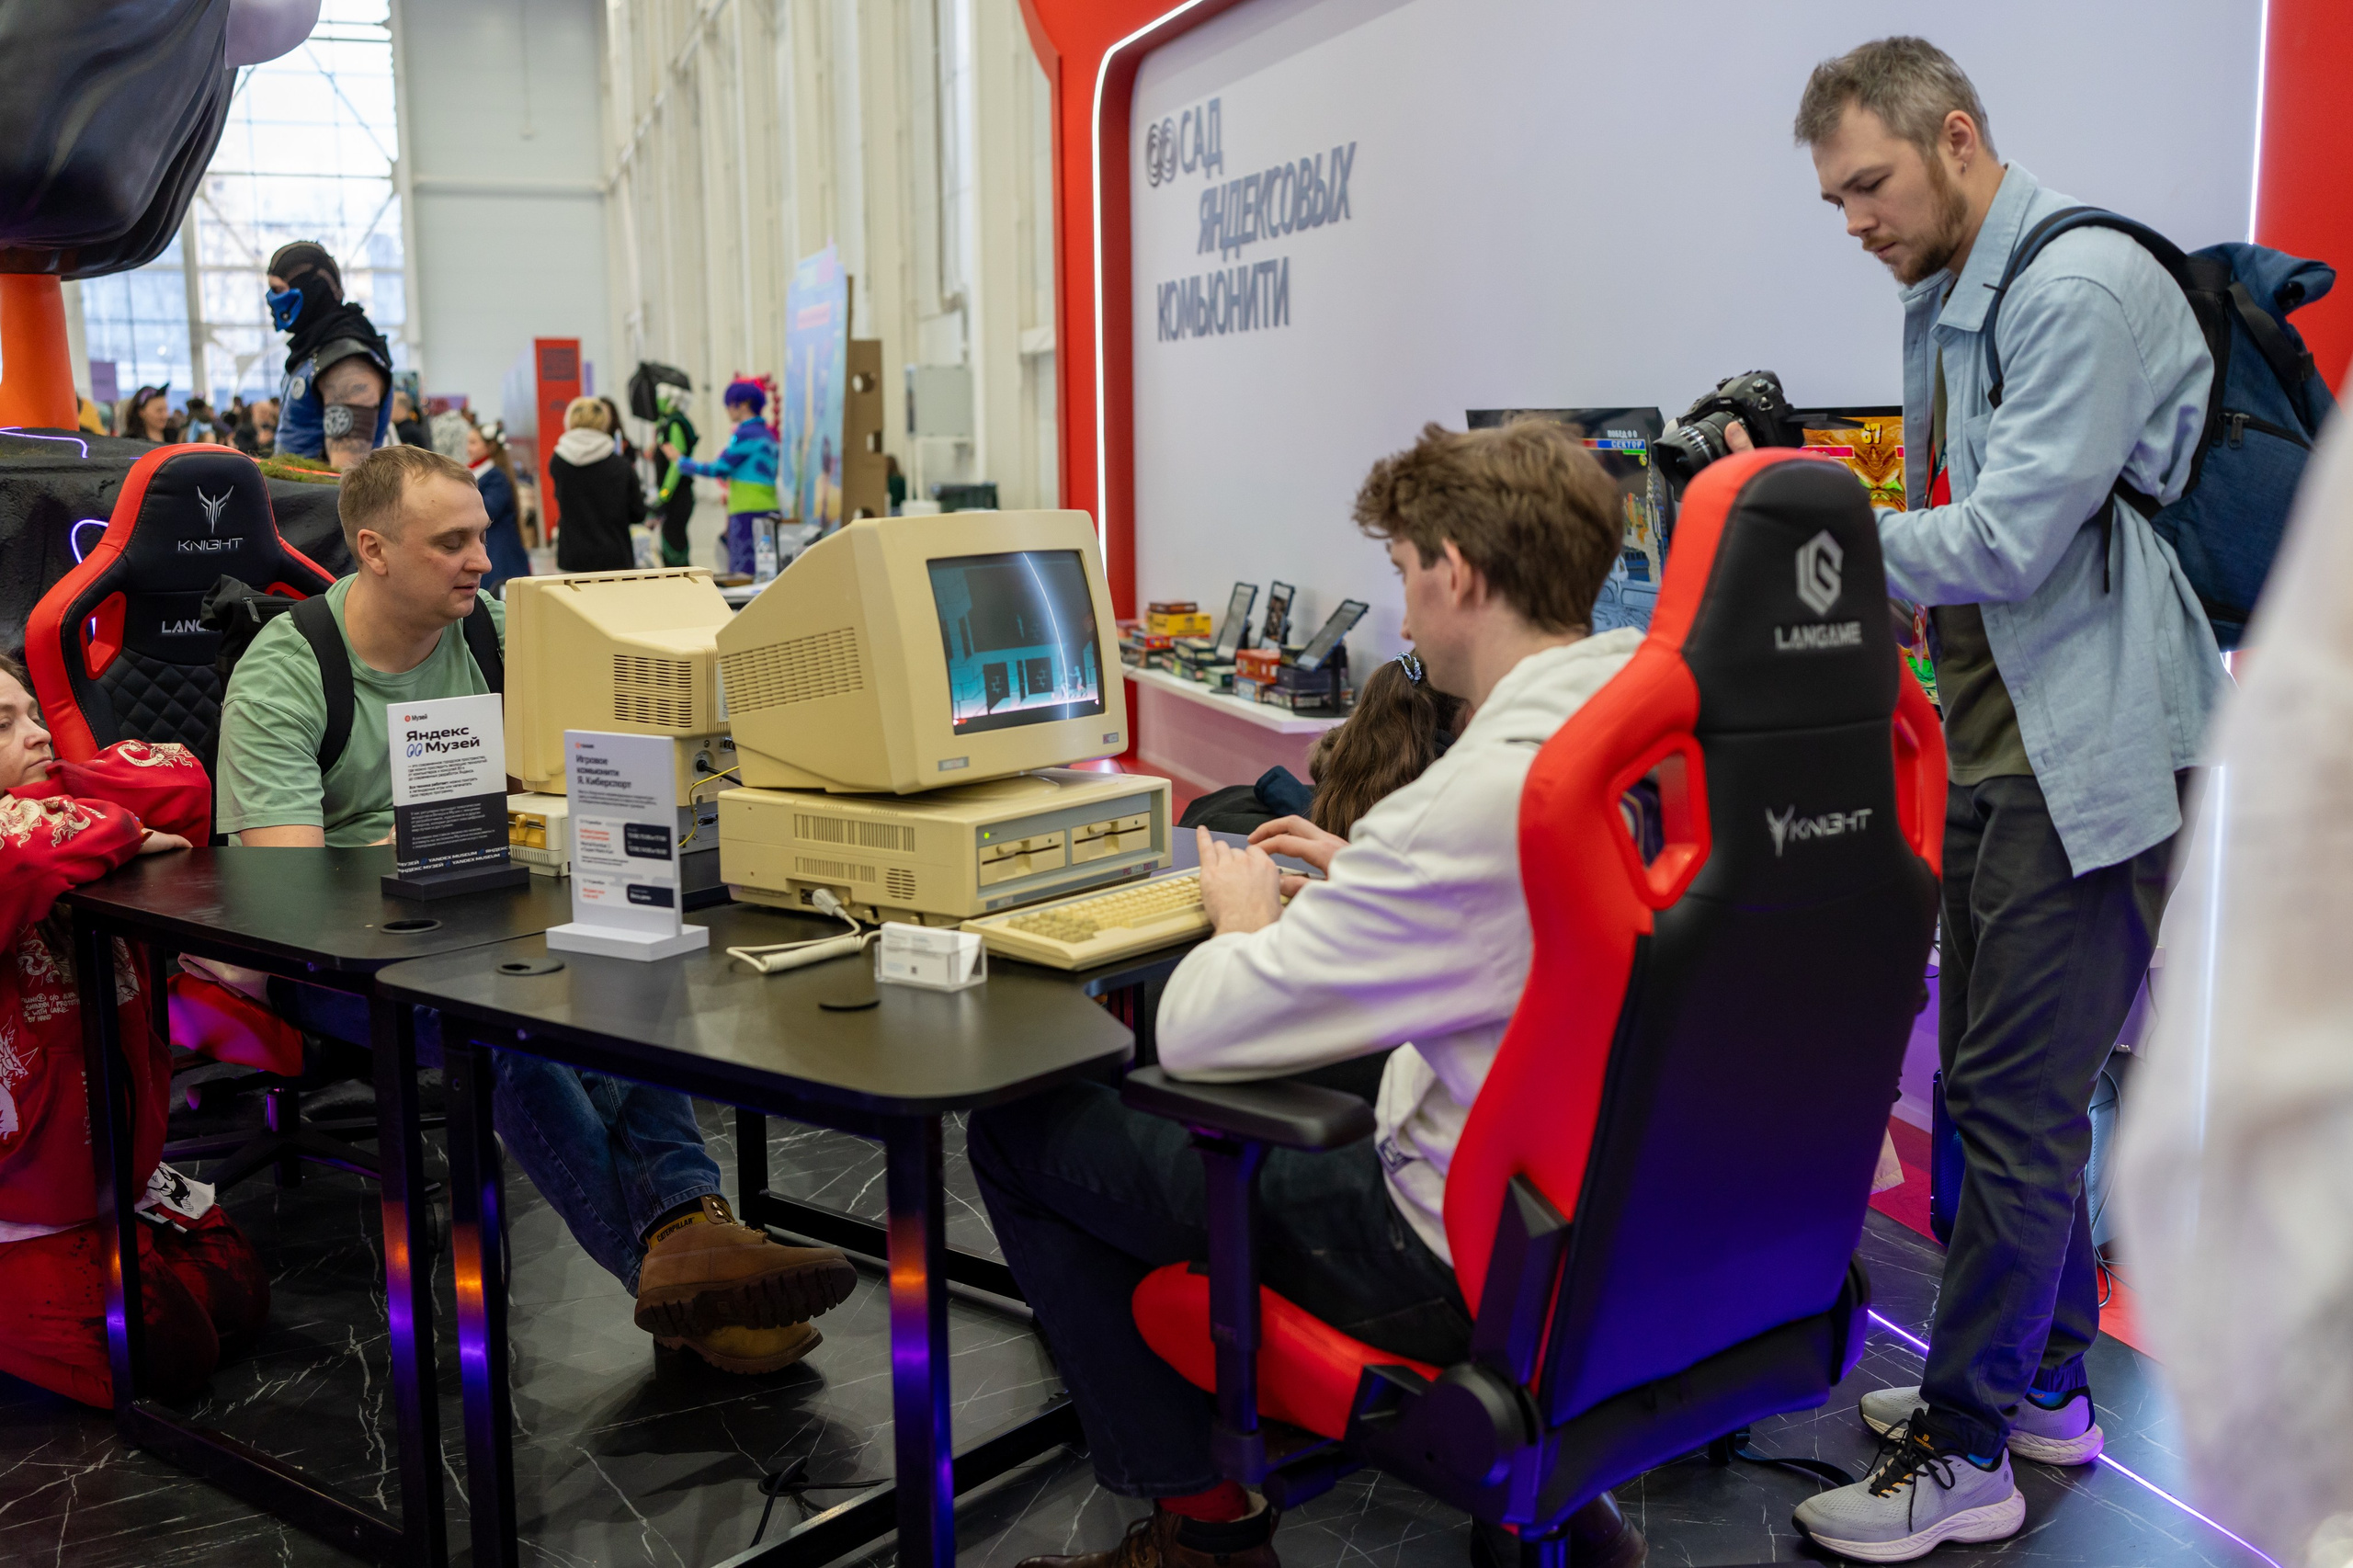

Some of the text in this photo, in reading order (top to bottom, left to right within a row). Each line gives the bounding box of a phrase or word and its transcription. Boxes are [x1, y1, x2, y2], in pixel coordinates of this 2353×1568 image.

[1180, 97, 1223, 178] САД
[1197, 142, 1357, 262] ЯНДЕКСОВЫХ
[1157, 256, 1290, 342] КОМЬЮНИТИ
[1611, 440, 1643, 449] СЕКТОР
[177, 538, 244, 551] KNIGHT
[1774, 620, 1863, 650] LANGAME
[411, 713, 427, 722] Музей
[406, 727, 470, 742] Яндекс
[426, 736, 480, 754] Музей
[576, 755, 608, 765] Игровое
[476, 853, 500, 861] MUSEUM
